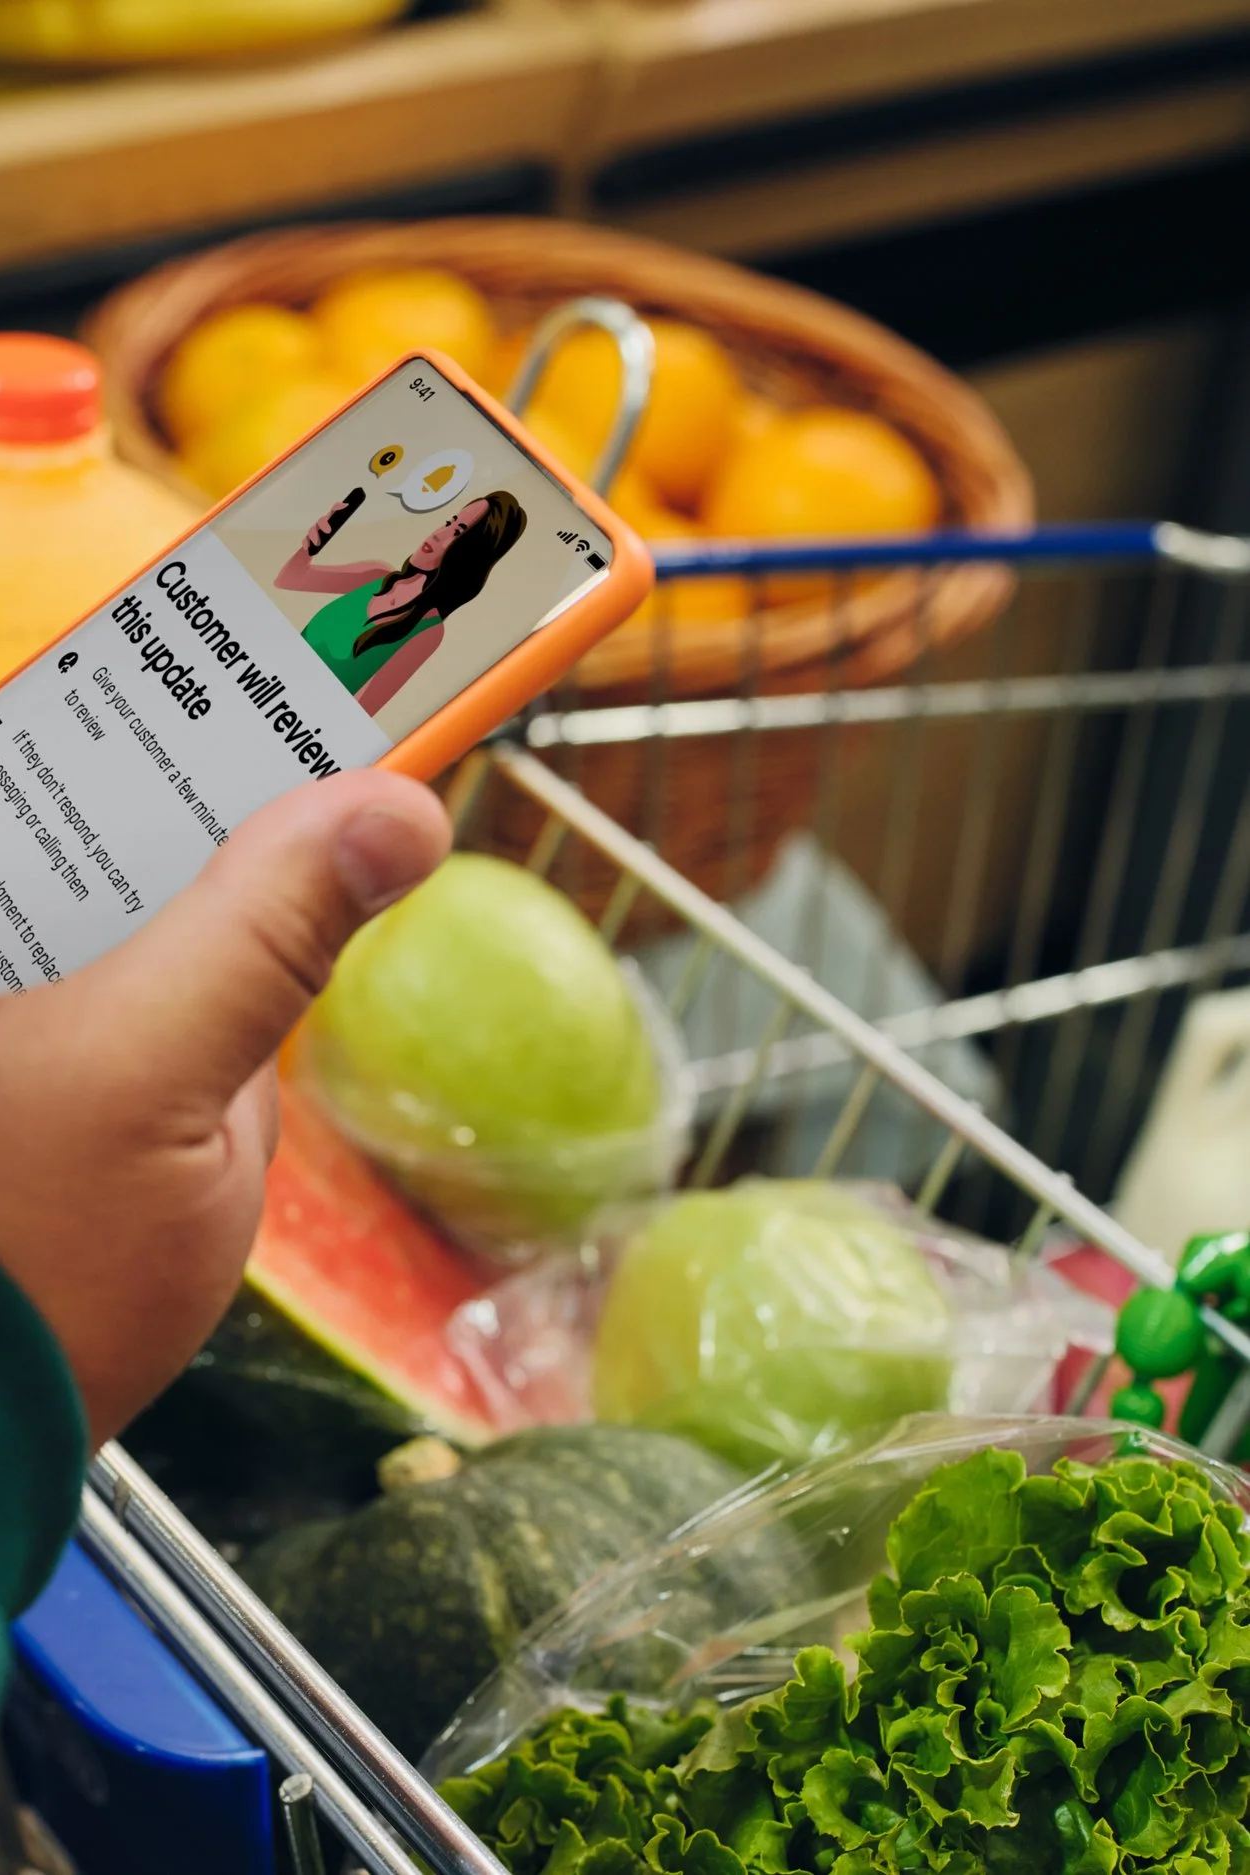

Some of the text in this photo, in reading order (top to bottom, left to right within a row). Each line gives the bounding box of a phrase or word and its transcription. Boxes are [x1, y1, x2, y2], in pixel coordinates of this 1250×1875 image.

[409, 377, 436, 402] 9:41
[111, 595, 212, 720] this update
[156, 561, 342, 782] Customer will review
[64, 688, 106, 741] to review
[92, 666, 116, 695] Give
[105, 692, 136, 720] your
[129, 718, 176, 772] customer
[168, 771, 181, 783] a
[175, 777, 198, 804] few
[12, 729, 145, 914] If they don't respond, you can try
[25, 814, 42, 829] or
[34, 827, 67, 872] calling
[61, 863, 90, 902] them
[20, 925, 35, 944] to
